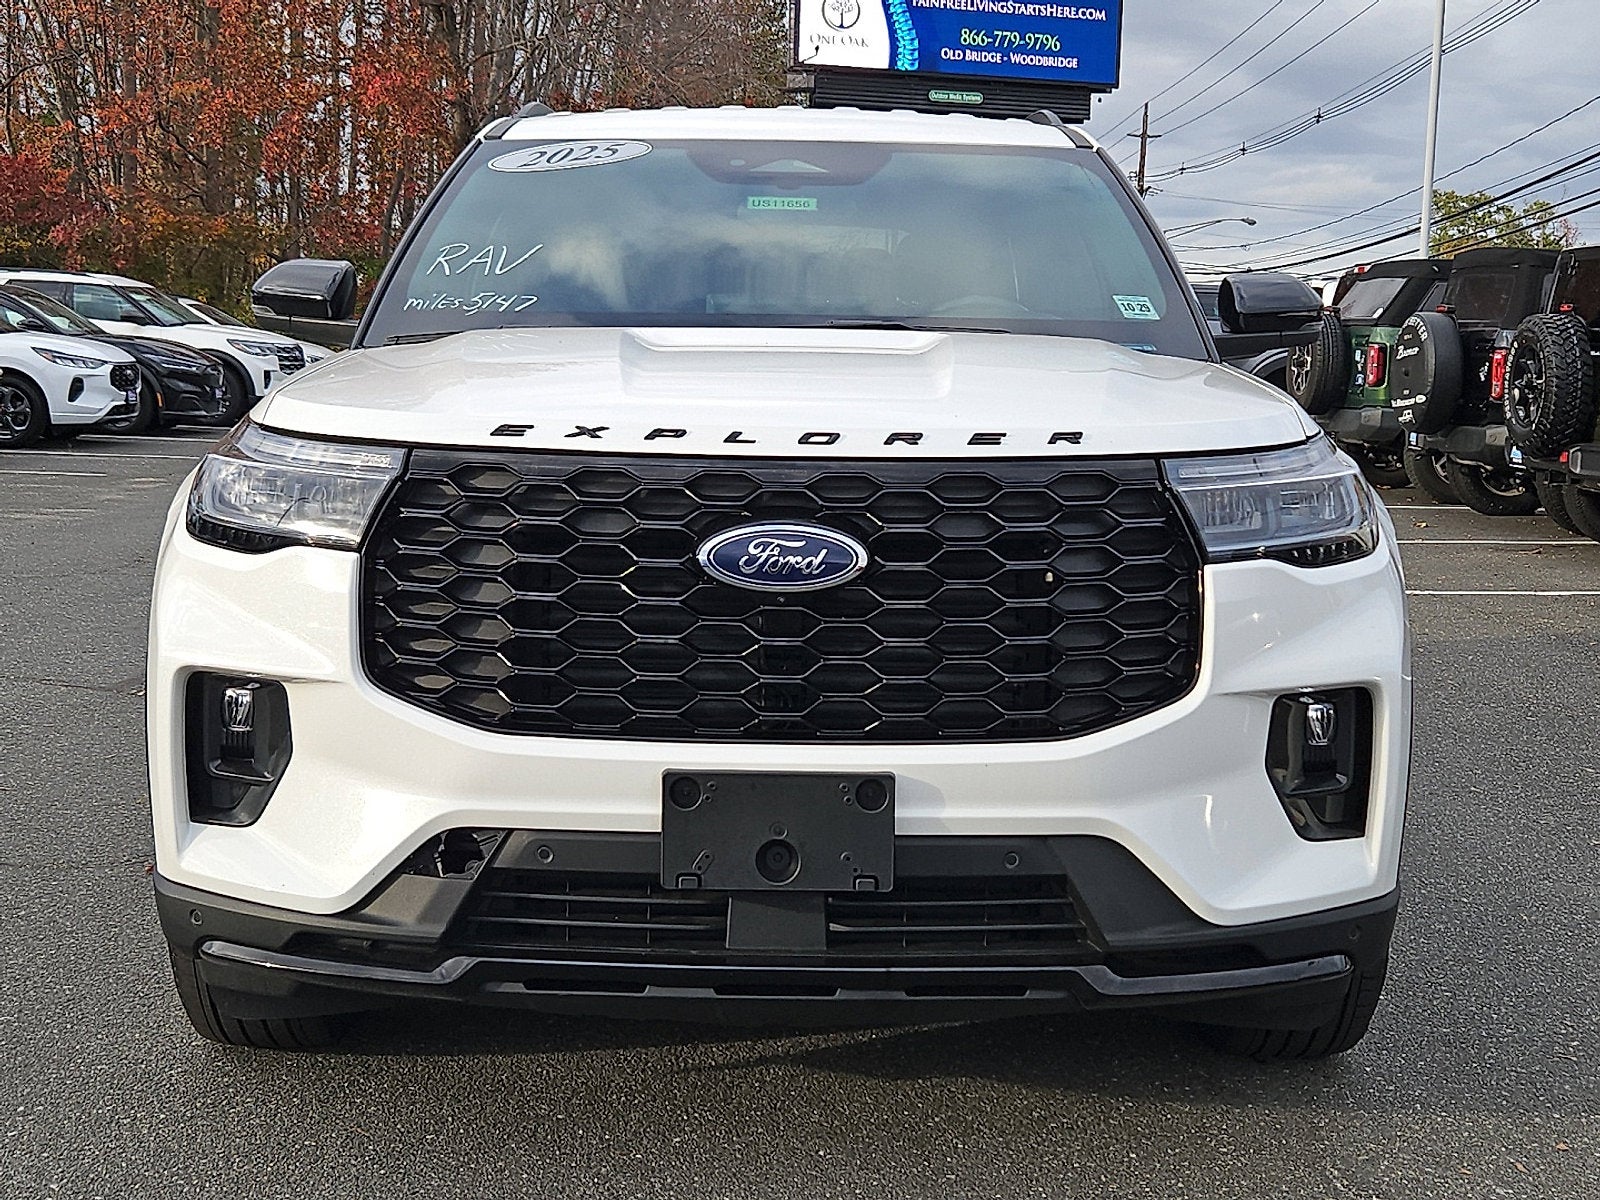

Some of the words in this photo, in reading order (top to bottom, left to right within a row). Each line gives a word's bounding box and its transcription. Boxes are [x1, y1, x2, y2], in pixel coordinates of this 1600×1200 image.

[960, 28, 1061, 51] 866-779-9796
[941, 47, 963, 60] OLD
[965, 49, 1002, 63] BRIDGE
[1009, 52, 1078, 68] WOODBRIDGE
[517, 143, 626, 168] 2025
[752, 199, 811, 208] US11656
[427, 243, 544, 276] RAV
[463, 292, 538, 316] 5147
[1121, 302, 1136, 312] 10
[1137, 303, 1151, 313] 29
[490, 424, 1084, 446] EXPLORER
[739, 537, 828, 575] Ford
